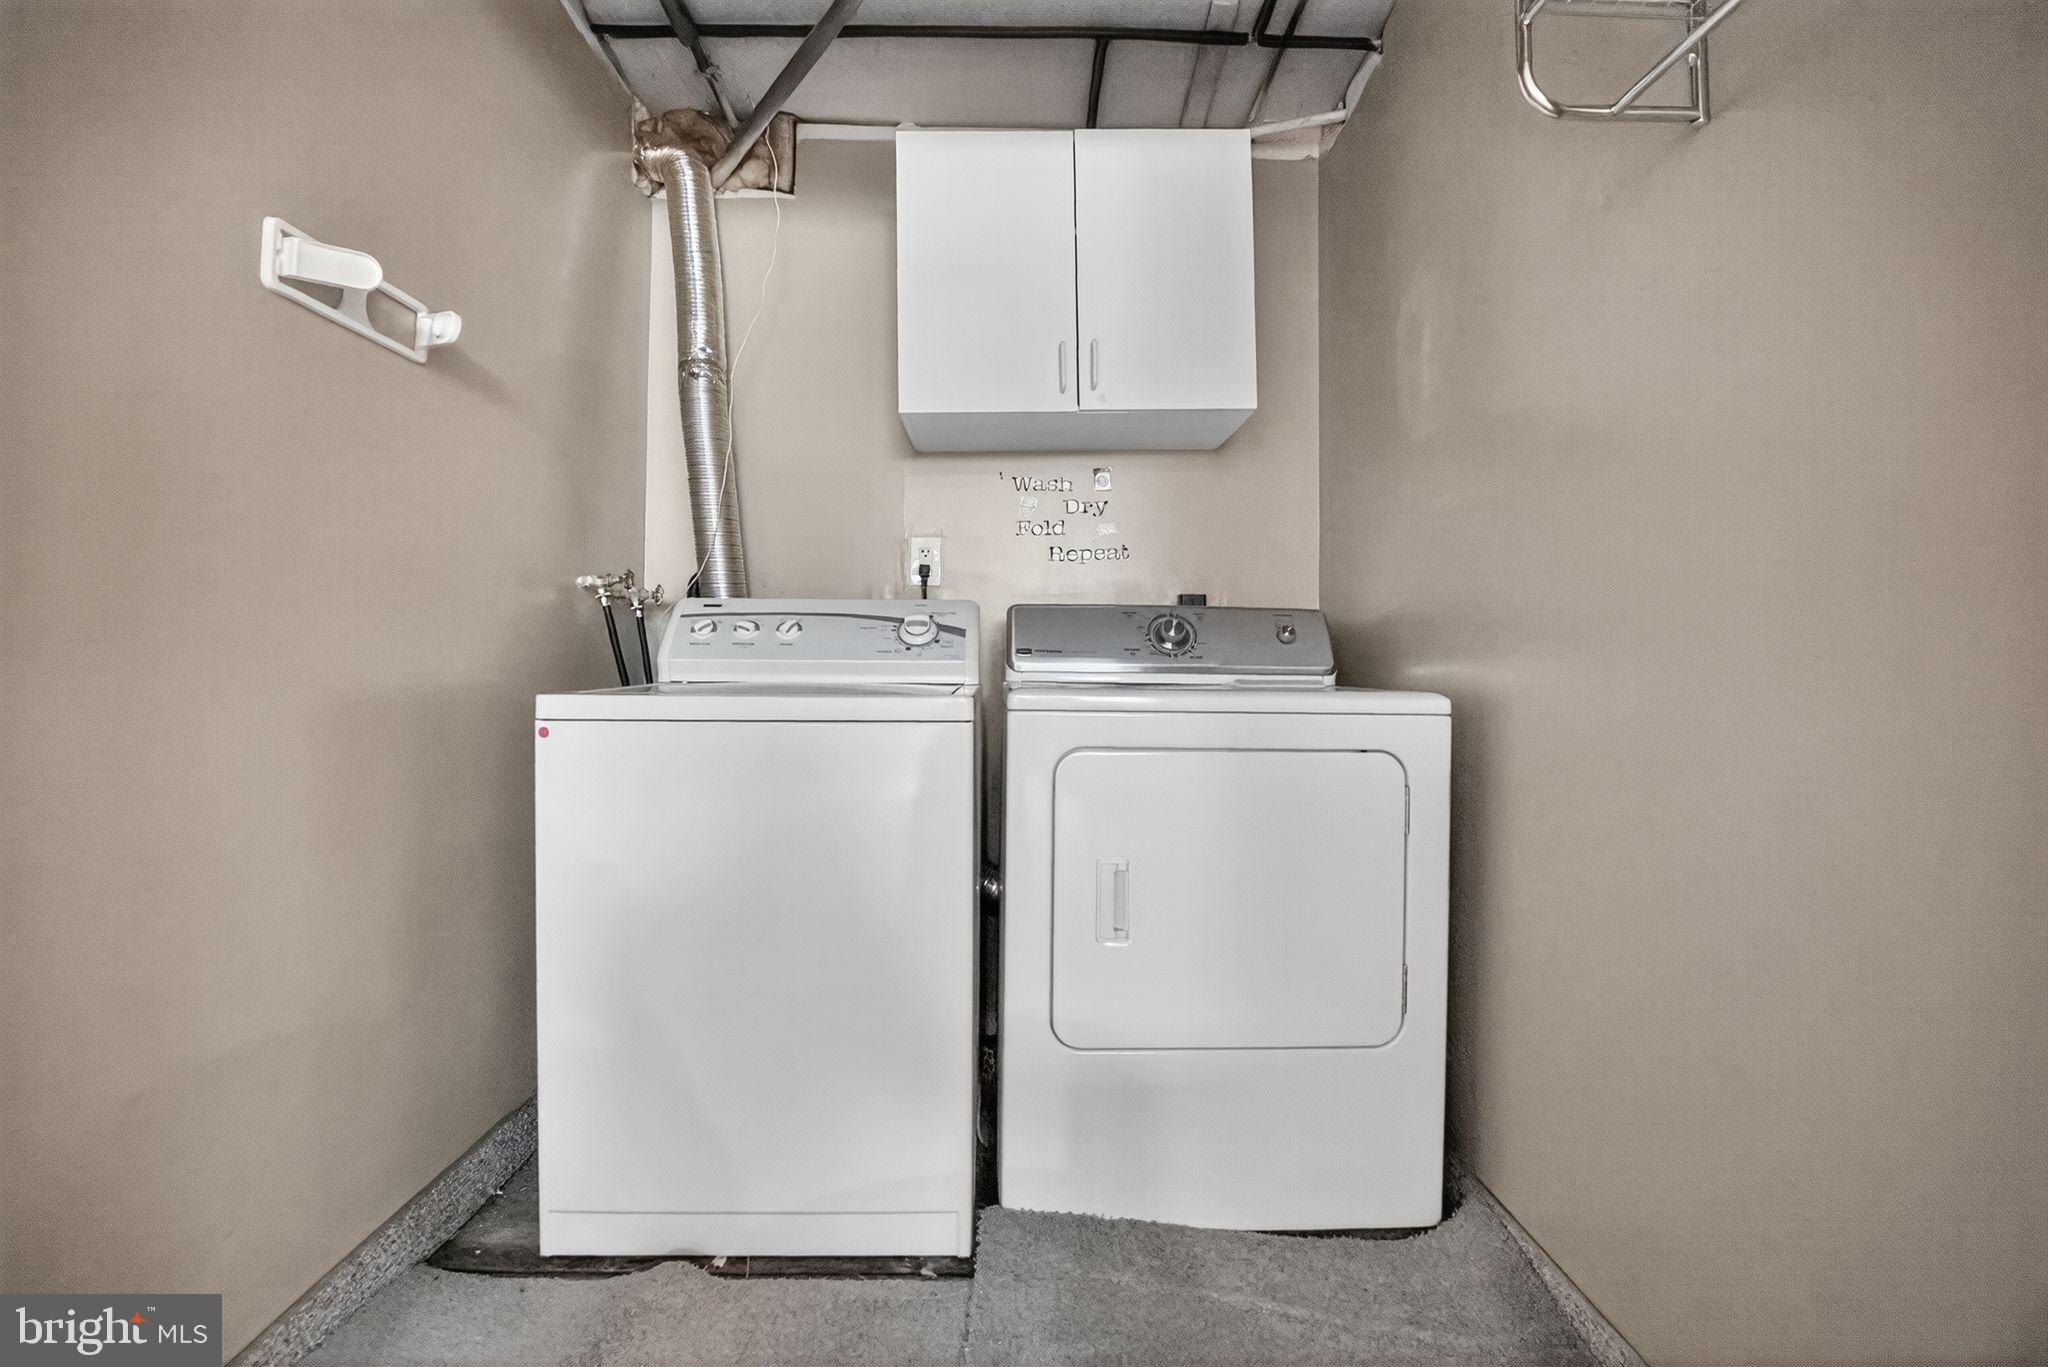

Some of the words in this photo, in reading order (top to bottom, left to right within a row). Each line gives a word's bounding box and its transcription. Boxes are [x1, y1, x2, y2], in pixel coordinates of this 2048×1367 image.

[1012, 476, 1073, 492] Wash
[1063, 499, 1108, 517] Dry
[1016, 520, 1066, 536] Fold
[1048, 545, 1130, 564] Repeat
